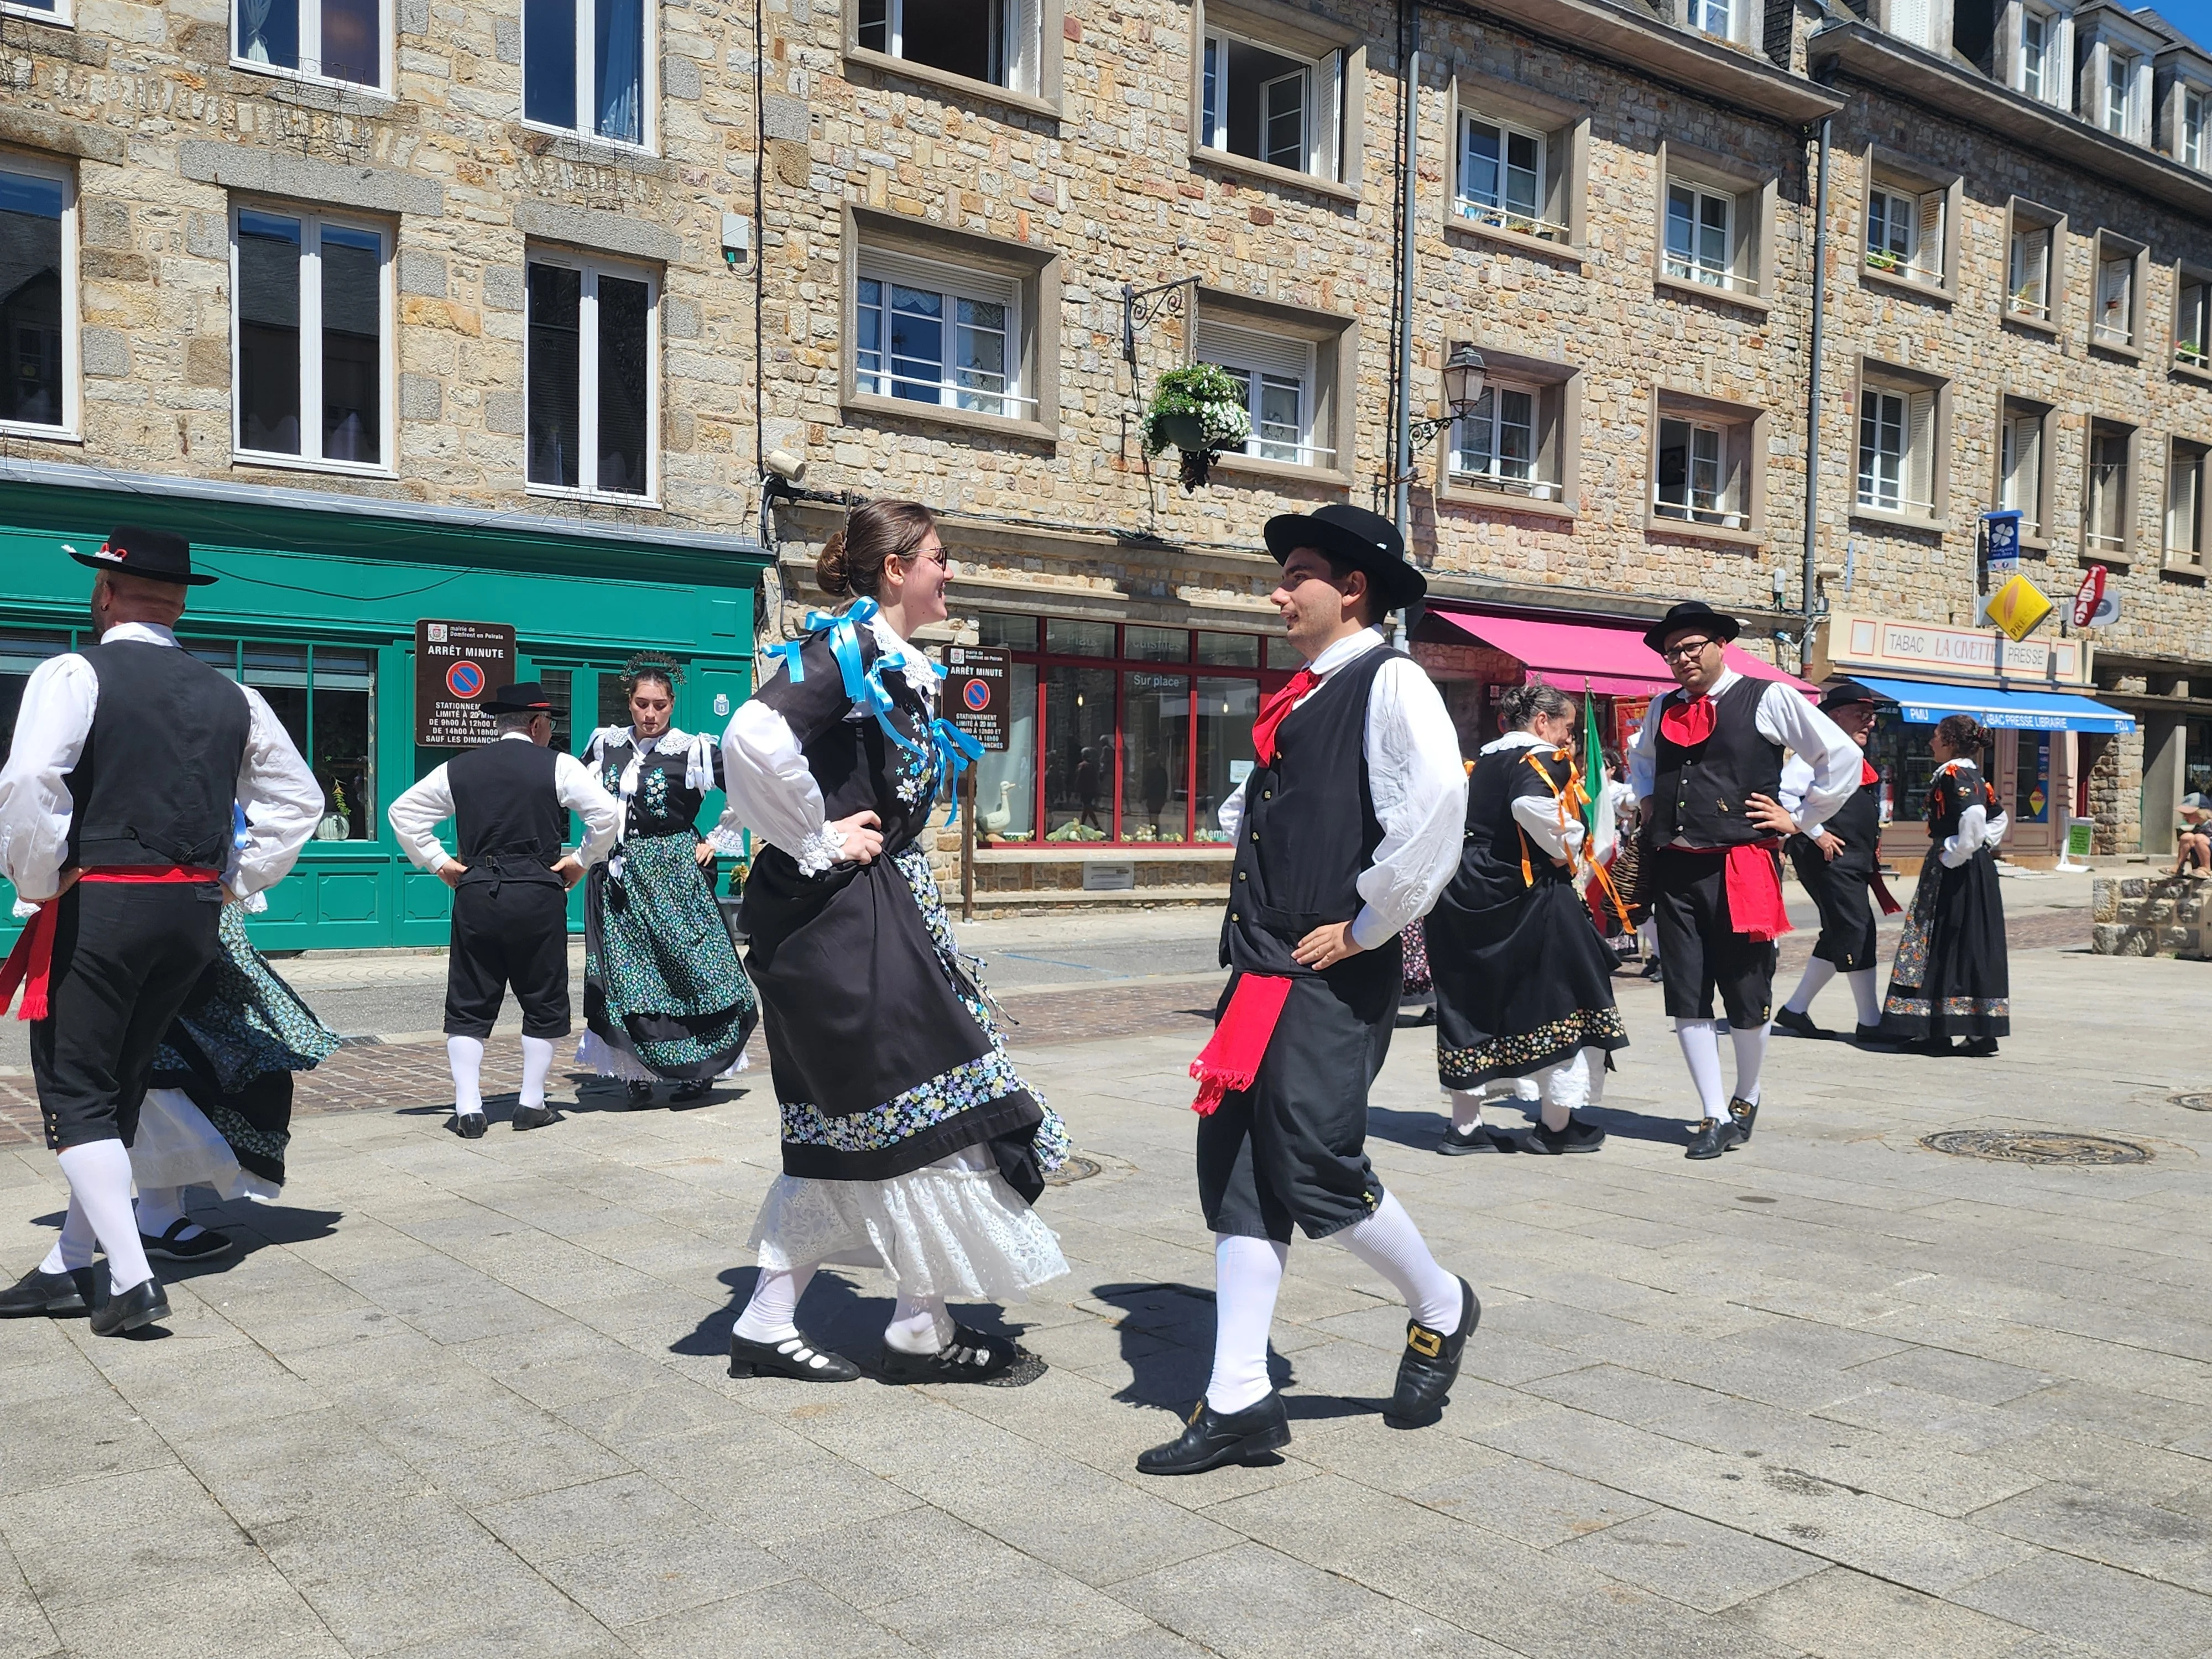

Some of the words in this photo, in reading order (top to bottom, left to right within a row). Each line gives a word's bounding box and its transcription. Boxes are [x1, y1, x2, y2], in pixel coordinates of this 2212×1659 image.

[2074, 566, 2100, 624] TABAC
[2010, 602, 2043, 637] PRESSE
[1066, 634, 1097, 647] Plats
[427, 645, 461, 656] ARRÊT
[465, 648, 504, 658] MINUTE
[1890, 634, 1924, 653] TABAC
[1935, 638, 1950, 657] LA
[1954, 640, 1997, 662] CIVETTE
[2007, 646, 2044, 665] PRESSE
[951, 665, 974, 675] ARRÊT
[976, 667, 1003, 677] MINUTE
[1134, 675, 1150, 686] Sur
[1153, 675, 1180, 687] place
[436, 702, 481, 710] STATIONNEM
[462, 709, 467, 718] À
[1910, 708, 1928, 721] PMU
[461, 718, 467, 727] À
[2005, 715, 2033, 727] PRESSE
[2035, 716, 2068, 728] LIBRAIRIE
[469, 727, 475, 735] À
